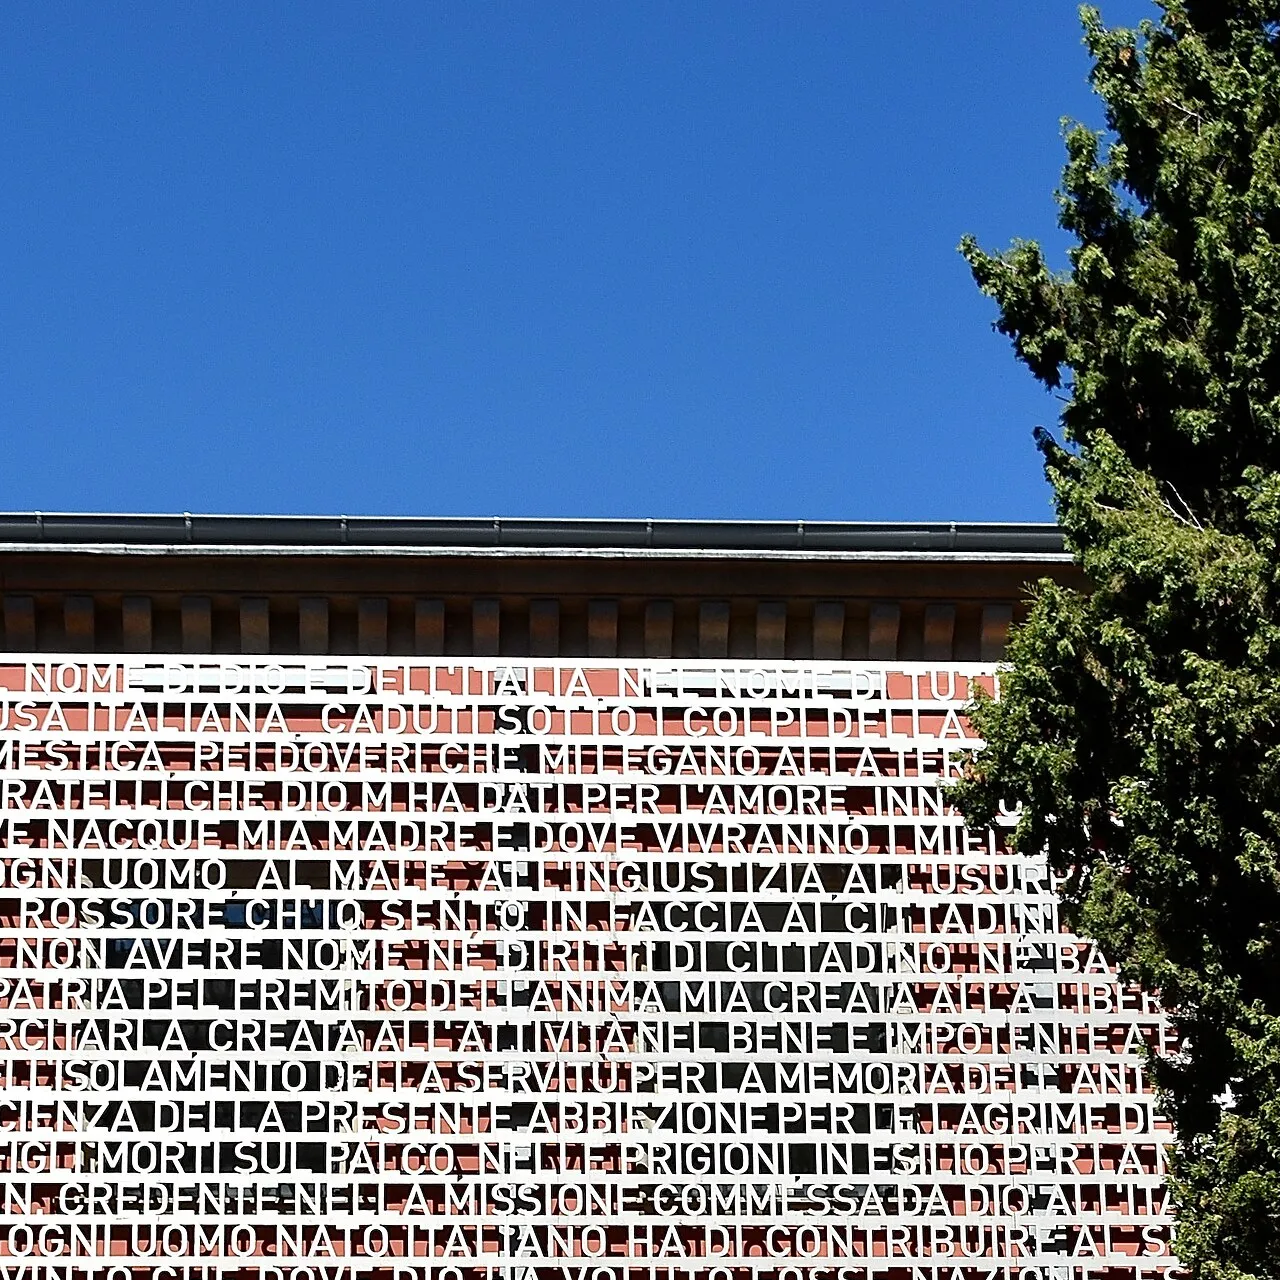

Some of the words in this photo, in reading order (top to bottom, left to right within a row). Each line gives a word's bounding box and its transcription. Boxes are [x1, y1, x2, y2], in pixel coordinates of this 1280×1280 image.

[26, 661, 144, 695] NOME
[621, 667, 700, 701] NEL
[717, 668, 833, 702] NOME
[321, 703, 478, 737] CADUTI
[498, 705, 637, 738] SOTTO
[684, 706, 807, 739] COLPI
[829, 708, 965, 740] DELLA
[195, 741, 255, 773] PEI
[276, 741, 421, 774] DOVERI
[440, 743, 526, 775] CHE
[596, 744, 760, 777] LEGANO
[773, 745, 881, 777] ALLA
[185, 780, 266, 812] CHE
[282, 780, 348, 813] DIO
[479, 782, 565, 814] DATI
[583, 783, 660, 815] PER
[49, 818, 220, 851] NACQUE
[240, 820, 313, 852] MIA
[329, 820, 475, 853] MADRE
[529, 821, 637, 854] DOVE
[654, 822, 868, 855] VIVRANNO
[915, 824, 997, 856] MIEI
[257, 859, 311, 891] AL
[20, 897, 225, 931] ROSSORE
[382, 899, 525, 932] SENTO
[611, 900, 764, 933] FACCIA
[844, 901, 1058, 934] CITTADINI
[16, 937, 105, 970] NON
[124, 938, 262, 970] AVERE
[284, 939, 403, 971] NOME
[507, 940, 653, 972] DIRITTI
[727, 941, 951, 974] CITTADINO
[145, 978, 219, 1011] PEL
[235, 978, 411, 1012] FREMITO
[680, 981, 753, 1013] MIA
[764, 981, 919, 1014] CREATA
[931, 982, 1034, 1014] ALLA
[209, 1019, 363, 1053] CREATA
[639, 1021, 716, 1054] NEL
[729, 1021, 833, 1054] BENE
[890, 1022, 1109, 1056] IMPOTENTE
[322, 1060, 447, 1093] DELLA
[632, 1061, 706, 1094] PER
[716, 1061, 765, 1094] LA
[776, 1061, 946, 1095] MEMORIA
[160, 1100, 285, 1133] DELLA
[302, 1100, 519, 1134] PRESENTE
[528, 1101, 768, 1134] ABBIEZIONE
[780, 1101, 855, 1135] PER
[933, 1102, 1106, 1135] LAGRIME
[98, 1140, 220, 1174] MORTI
[235, 1141, 312, 1175] SUL
[481, 1141, 605, 1175] NELLE
[871, 1142, 990, 1176] ESILIO
[1005, 1142, 1079, 1176] PER
[1095, 1142, 1144, 1176] LA
[60, 1182, 282, 1216] CREDENTE
[295, 1182, 429, 1216] NELLA
[445, 1182, 639, 1216] MISSIONE
[653, 1183, 887, 1217] COMMESSA
[905, 1183, 951, 1217] DA
[966, 1183, 1029, 1217] DIO
[8, 1223, 109, 1257] OGNI
[132, 1223, 257, 1257] UOMO
[278, 1223, 390, 1257] NATO
[407, 1223, 607, 1258] ITALIANO
[629, 1224, 685, 1258] HA
[766, 1224, 1057, 1258] CONTRIBUIRE
[1073, 1224, 1126, 1258] AL
